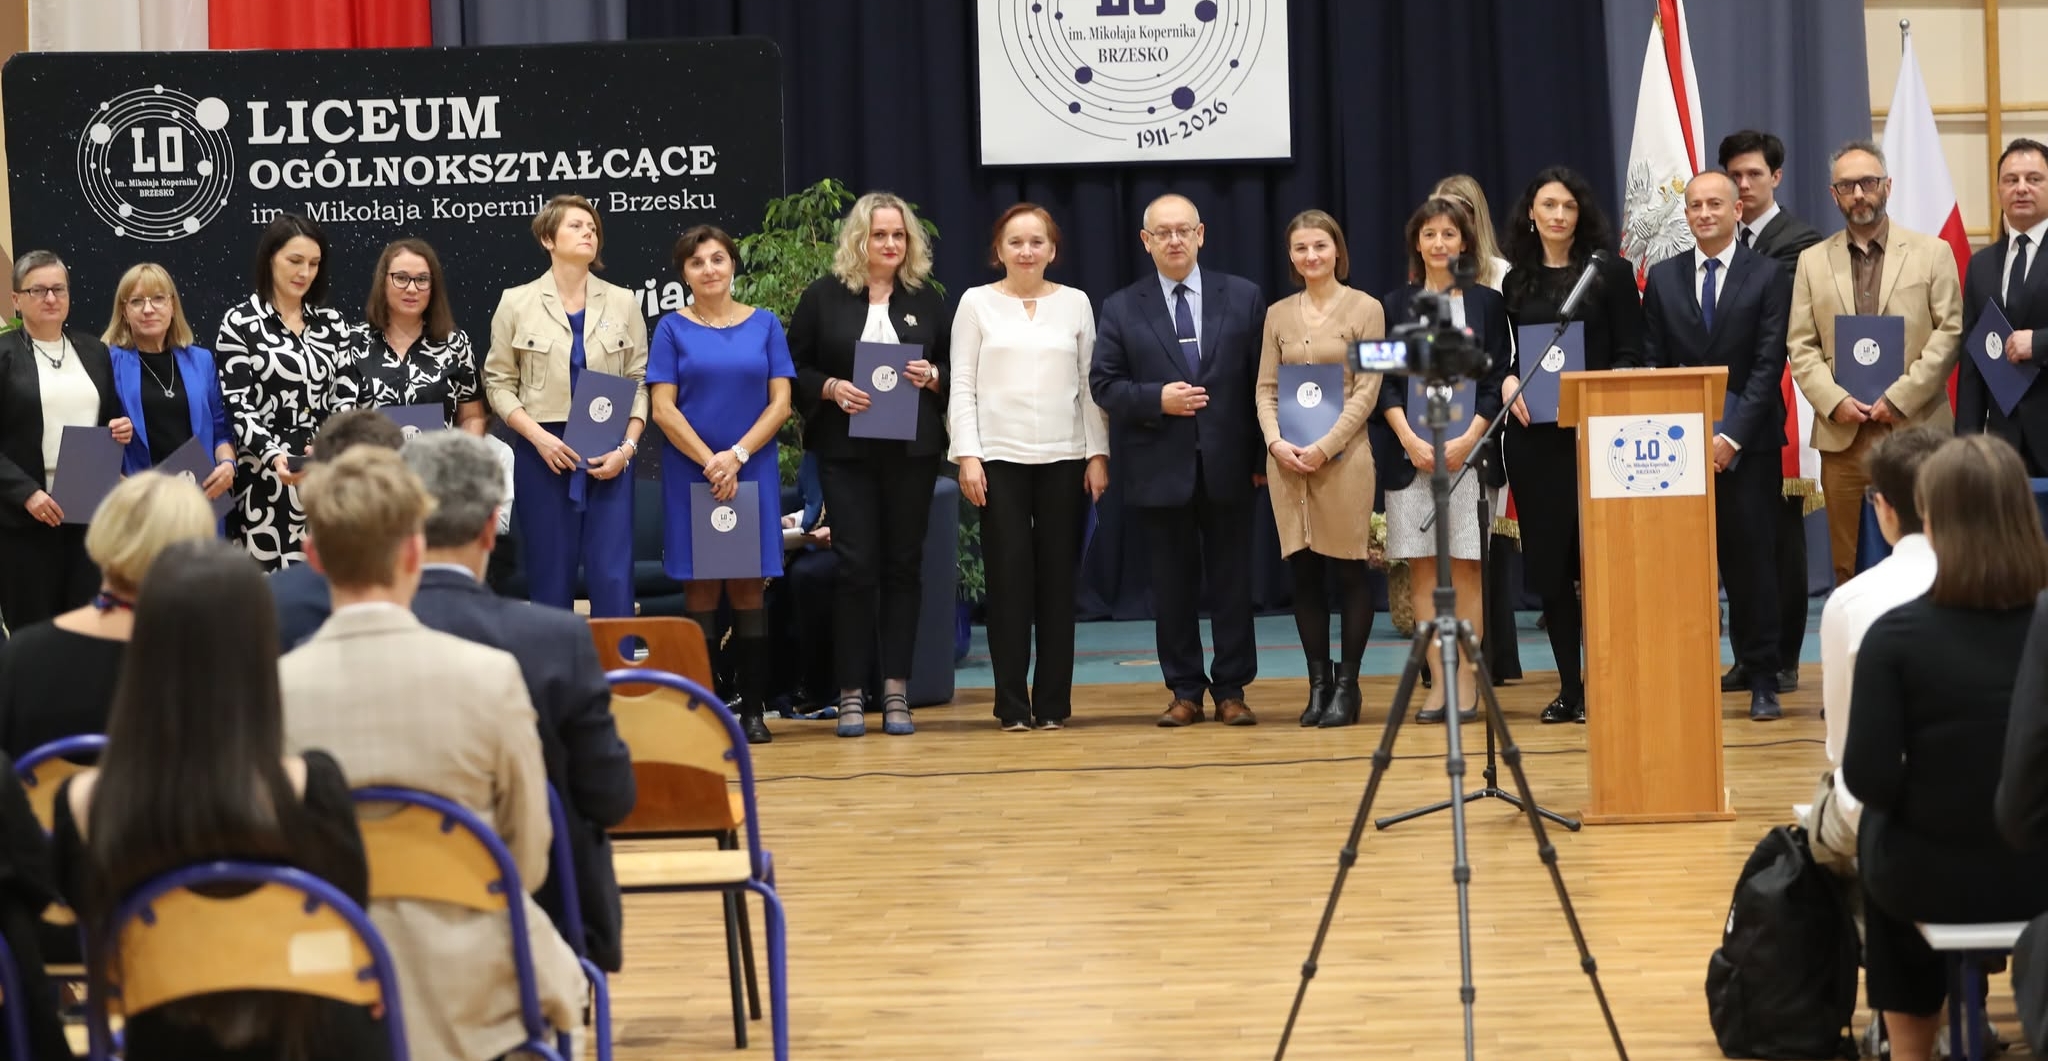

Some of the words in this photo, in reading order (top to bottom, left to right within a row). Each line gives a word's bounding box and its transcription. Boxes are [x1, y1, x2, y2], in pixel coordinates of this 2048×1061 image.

[1068, 26, 1086, 41] im.
[1139, 23, 1196, 42] Kopernika
[1098, 46, 1169, 63] BRZESKO
[247, 96, 501, 144] LICEUM
[1136, 98, 1228, 149] 1911-2026
[131, 127, 184, 172] LO
[249, 145, 717, 189] OGÓLNOKSZTAŁCĄCE
[139, 188, 175, 198] BRZESKO
[161, 177, 198, 188] Kopernika
[305, 199, 423, 226] Mikołaja
[431, 193, 553, 224] Kopernik
[609, 188, 717, 213] Brzesku
[1635, 440, 1660, 461] LO
